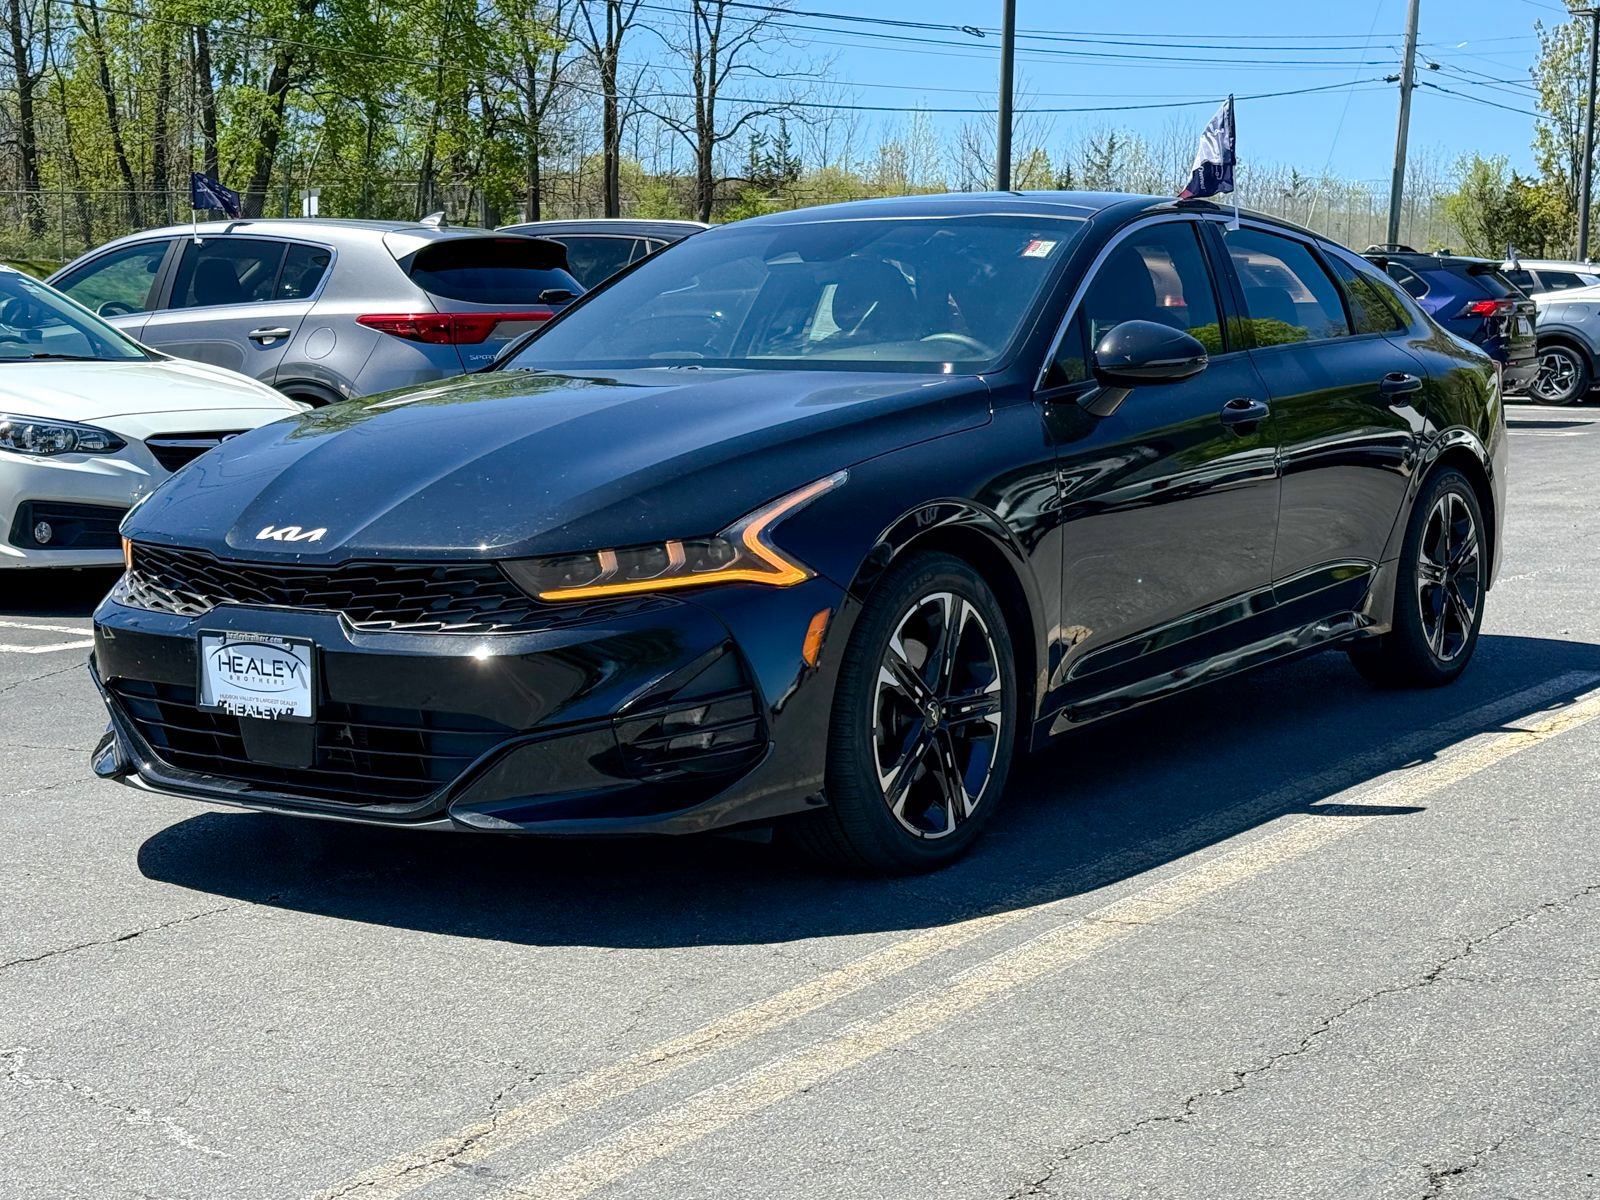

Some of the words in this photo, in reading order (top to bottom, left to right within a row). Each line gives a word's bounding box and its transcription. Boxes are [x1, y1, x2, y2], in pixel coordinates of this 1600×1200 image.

[256, 525, 328, 543] KIA
[218, 655, 298, 679] HEALEY
[229, 675, 285, 685] BROTHERS
[226, 703, 282, 720] HEALEY
